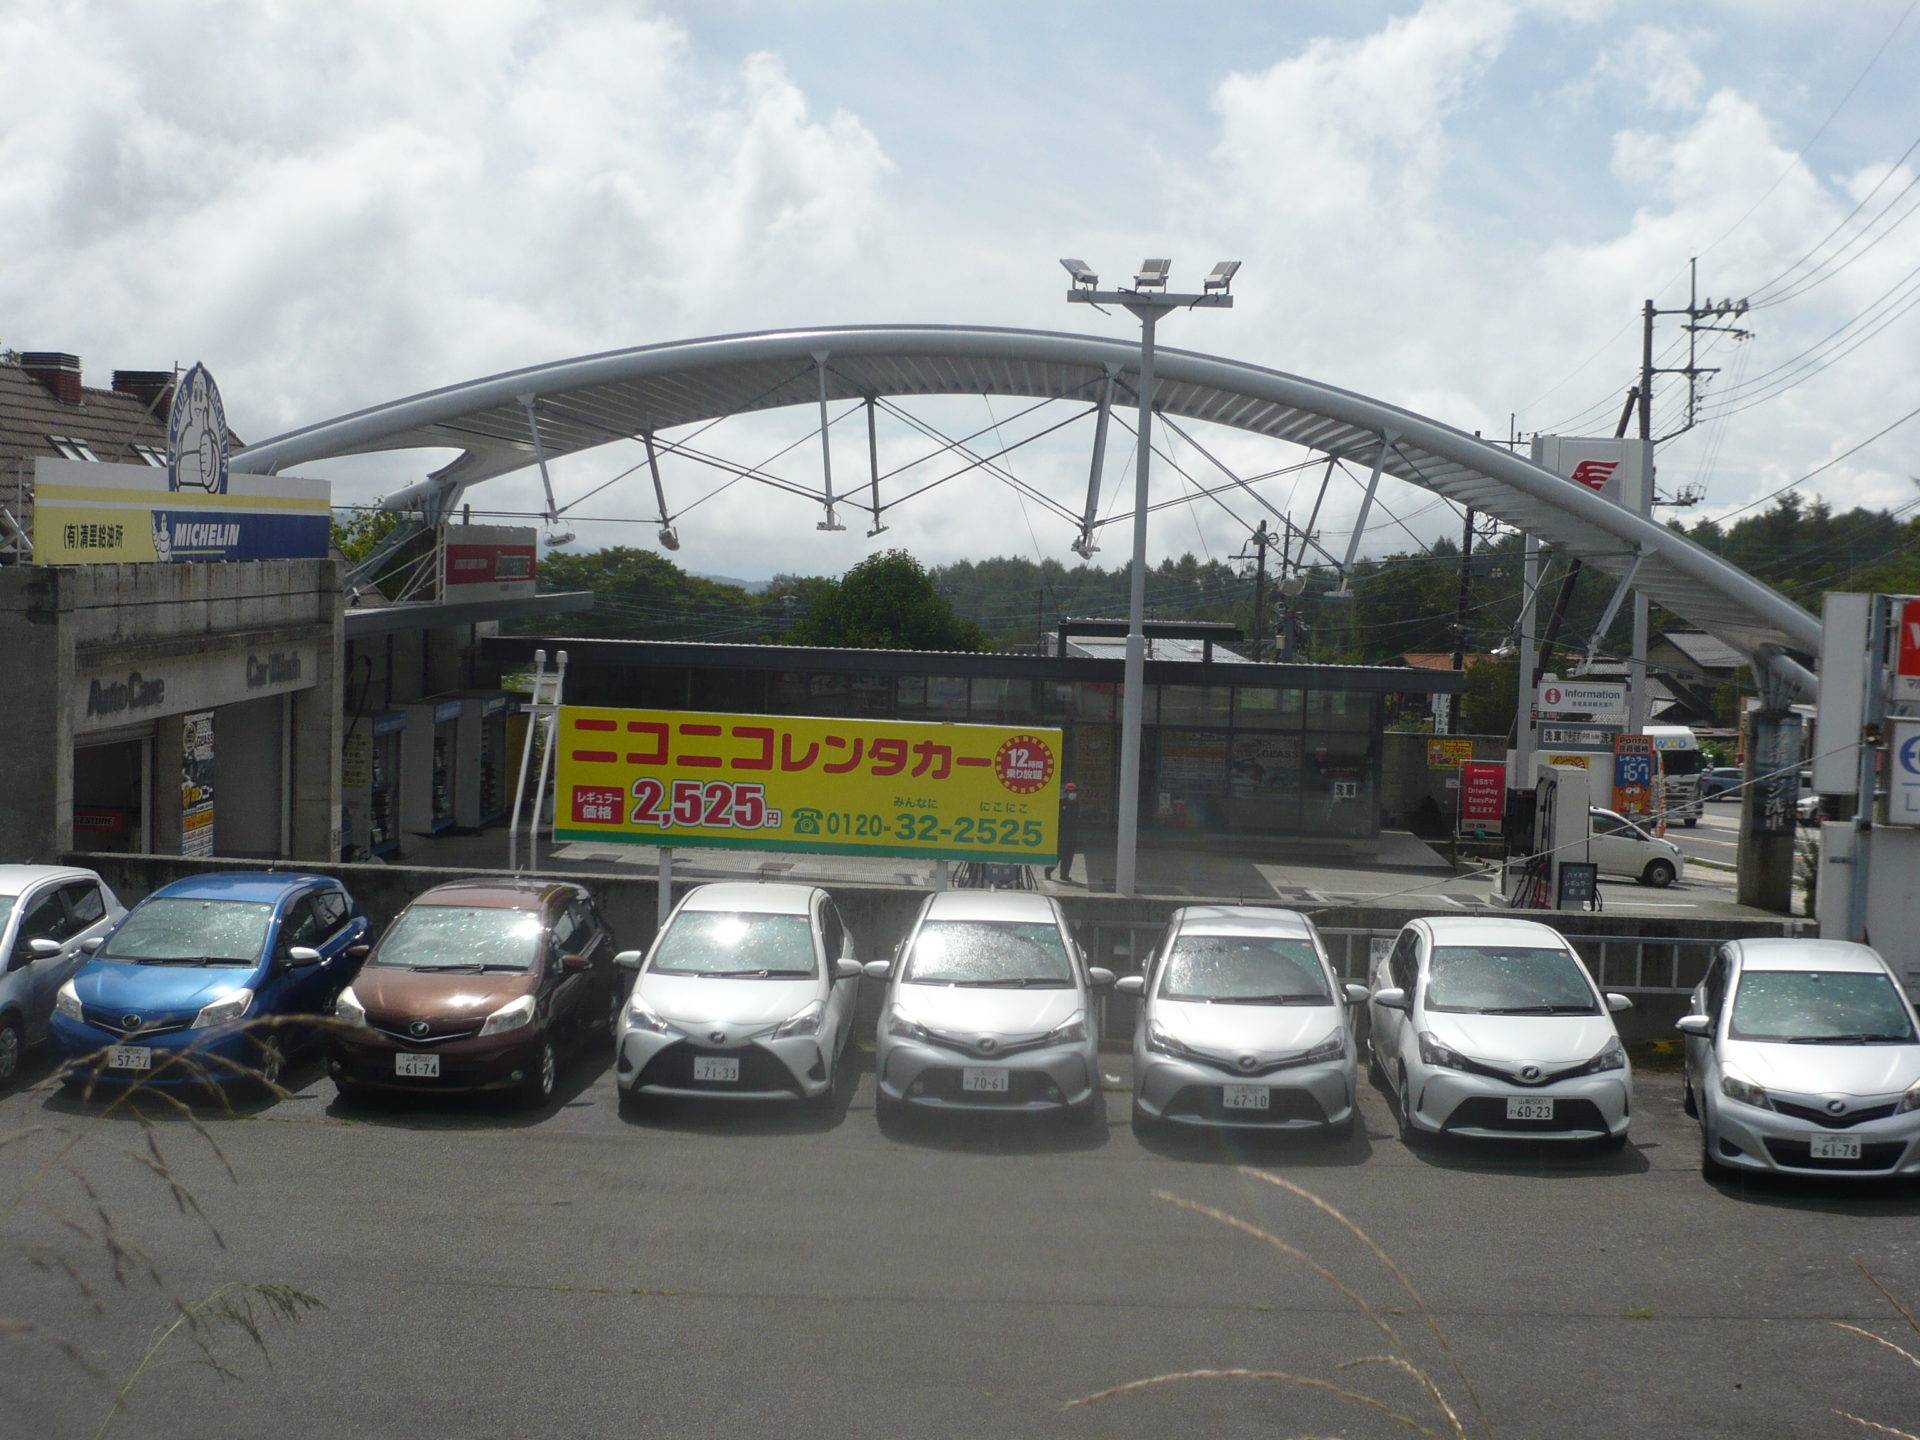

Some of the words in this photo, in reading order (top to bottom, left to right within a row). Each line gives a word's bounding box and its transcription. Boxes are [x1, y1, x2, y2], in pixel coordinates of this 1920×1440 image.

[172, 383, 188, 432] CLUB
[208, 383, 229, 473] MICHELIN
[173, 523, 240, 547] MICHELIN
[87, 676, 128, 717] Auto
[128, 671, 165, 709] Care
[1565, 689, 1620, 699] Information
[572, 719, 992, 780] ニコニコレンタカー
[577, 791, 622, 804] レギュラー
[1468, 787, 1499, 796] DrivePay
[632, 779, 781, 829] 2,525円
[892, 796, 938, 809] みんなに
[979, 800, 1029, 814] にこにこ
[1468, 796, 1497, 805] EasyPay
[582, 805, 612, 820] 価格
[827, 813, 1043, 847] 0120-32-2525
[405, 1063, 437, 1075] 61-74
[1517, 1106, 1551, 1118] 60-23
[1822, 1144, 1858, 1157] 61-78
